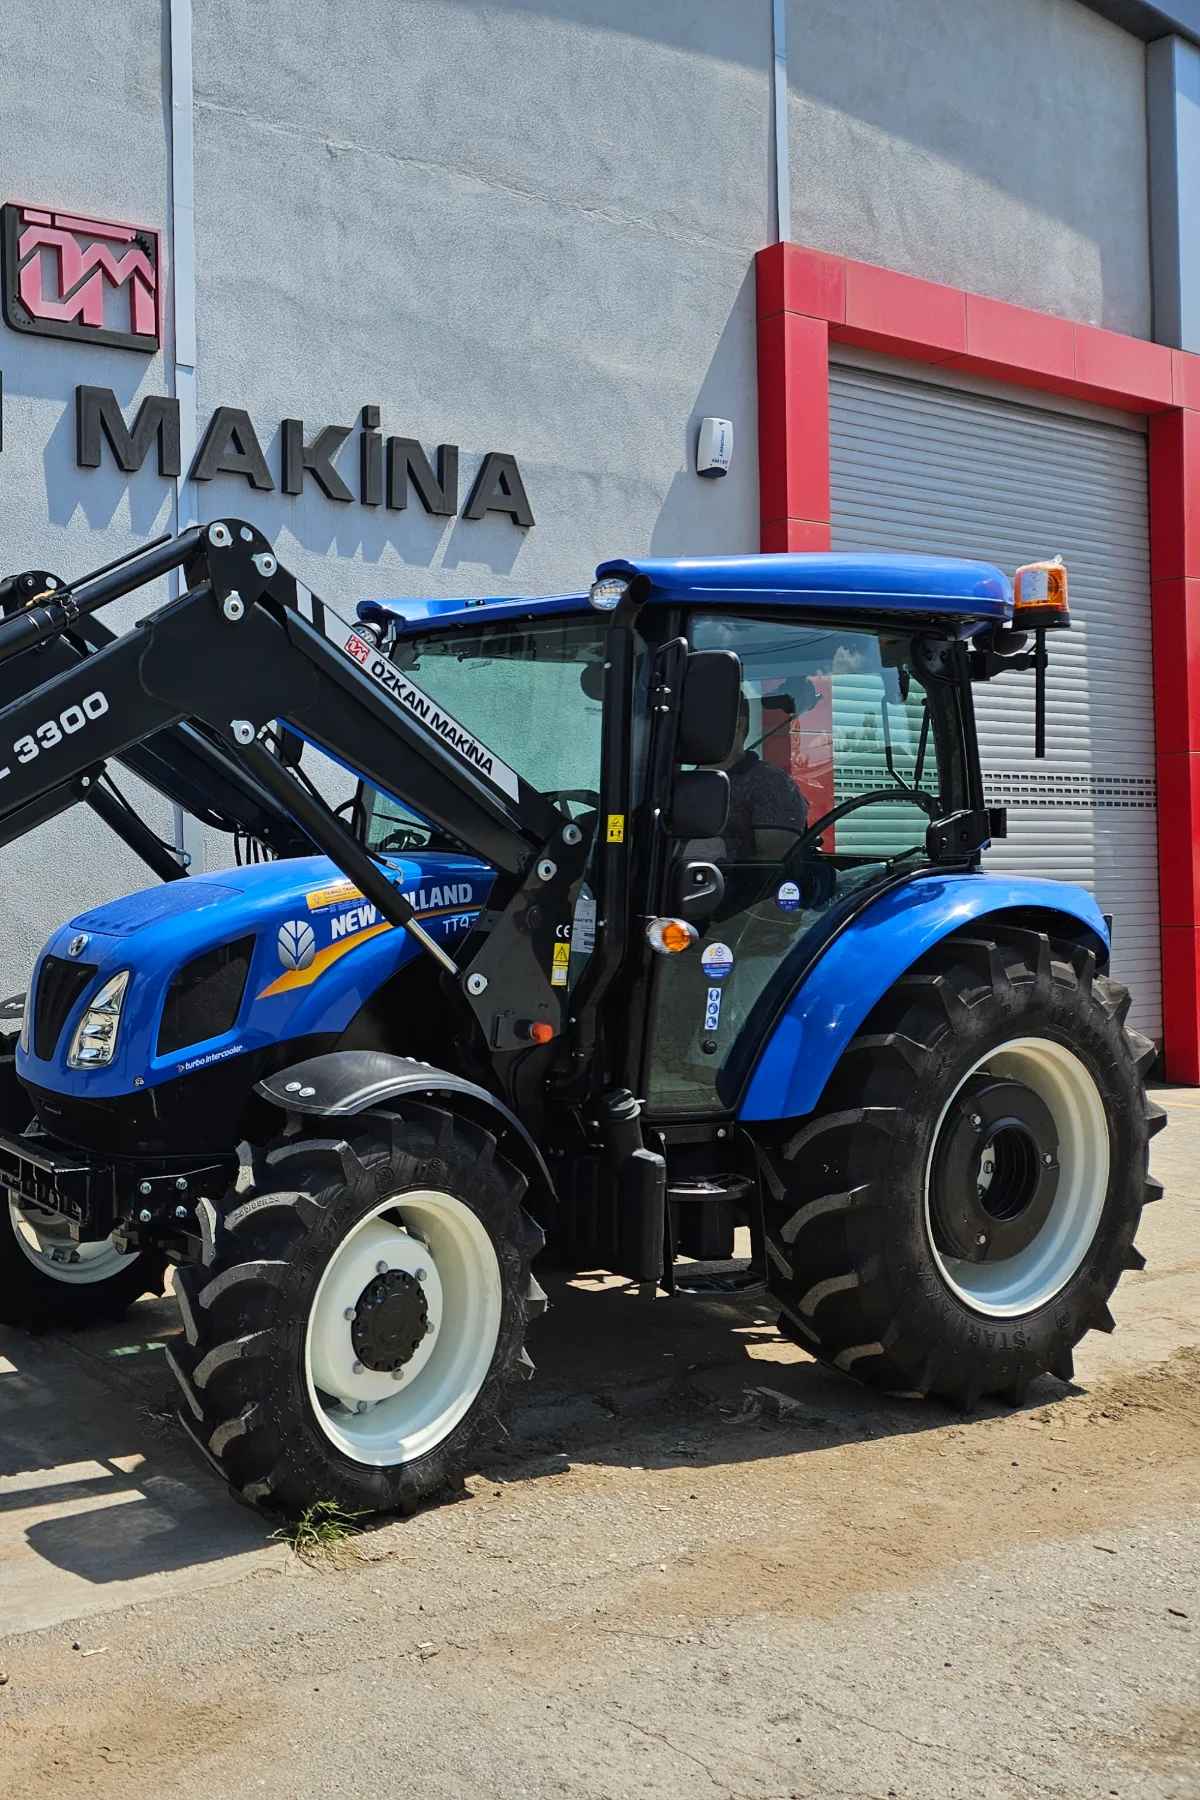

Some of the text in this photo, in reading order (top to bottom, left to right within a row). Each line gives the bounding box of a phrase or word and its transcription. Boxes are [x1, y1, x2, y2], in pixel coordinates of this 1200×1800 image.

[76, 385, 536, 528] MAKİNA
[13, 690, 109, 764] 3300
[371, 659, 493, 776] ÖZKAN MAKİNA
[331, 904, 377, 940] NEW
[381, 883, 473, 921] LLAND
[185, 1044, 244, 1071] turbo intercooler
